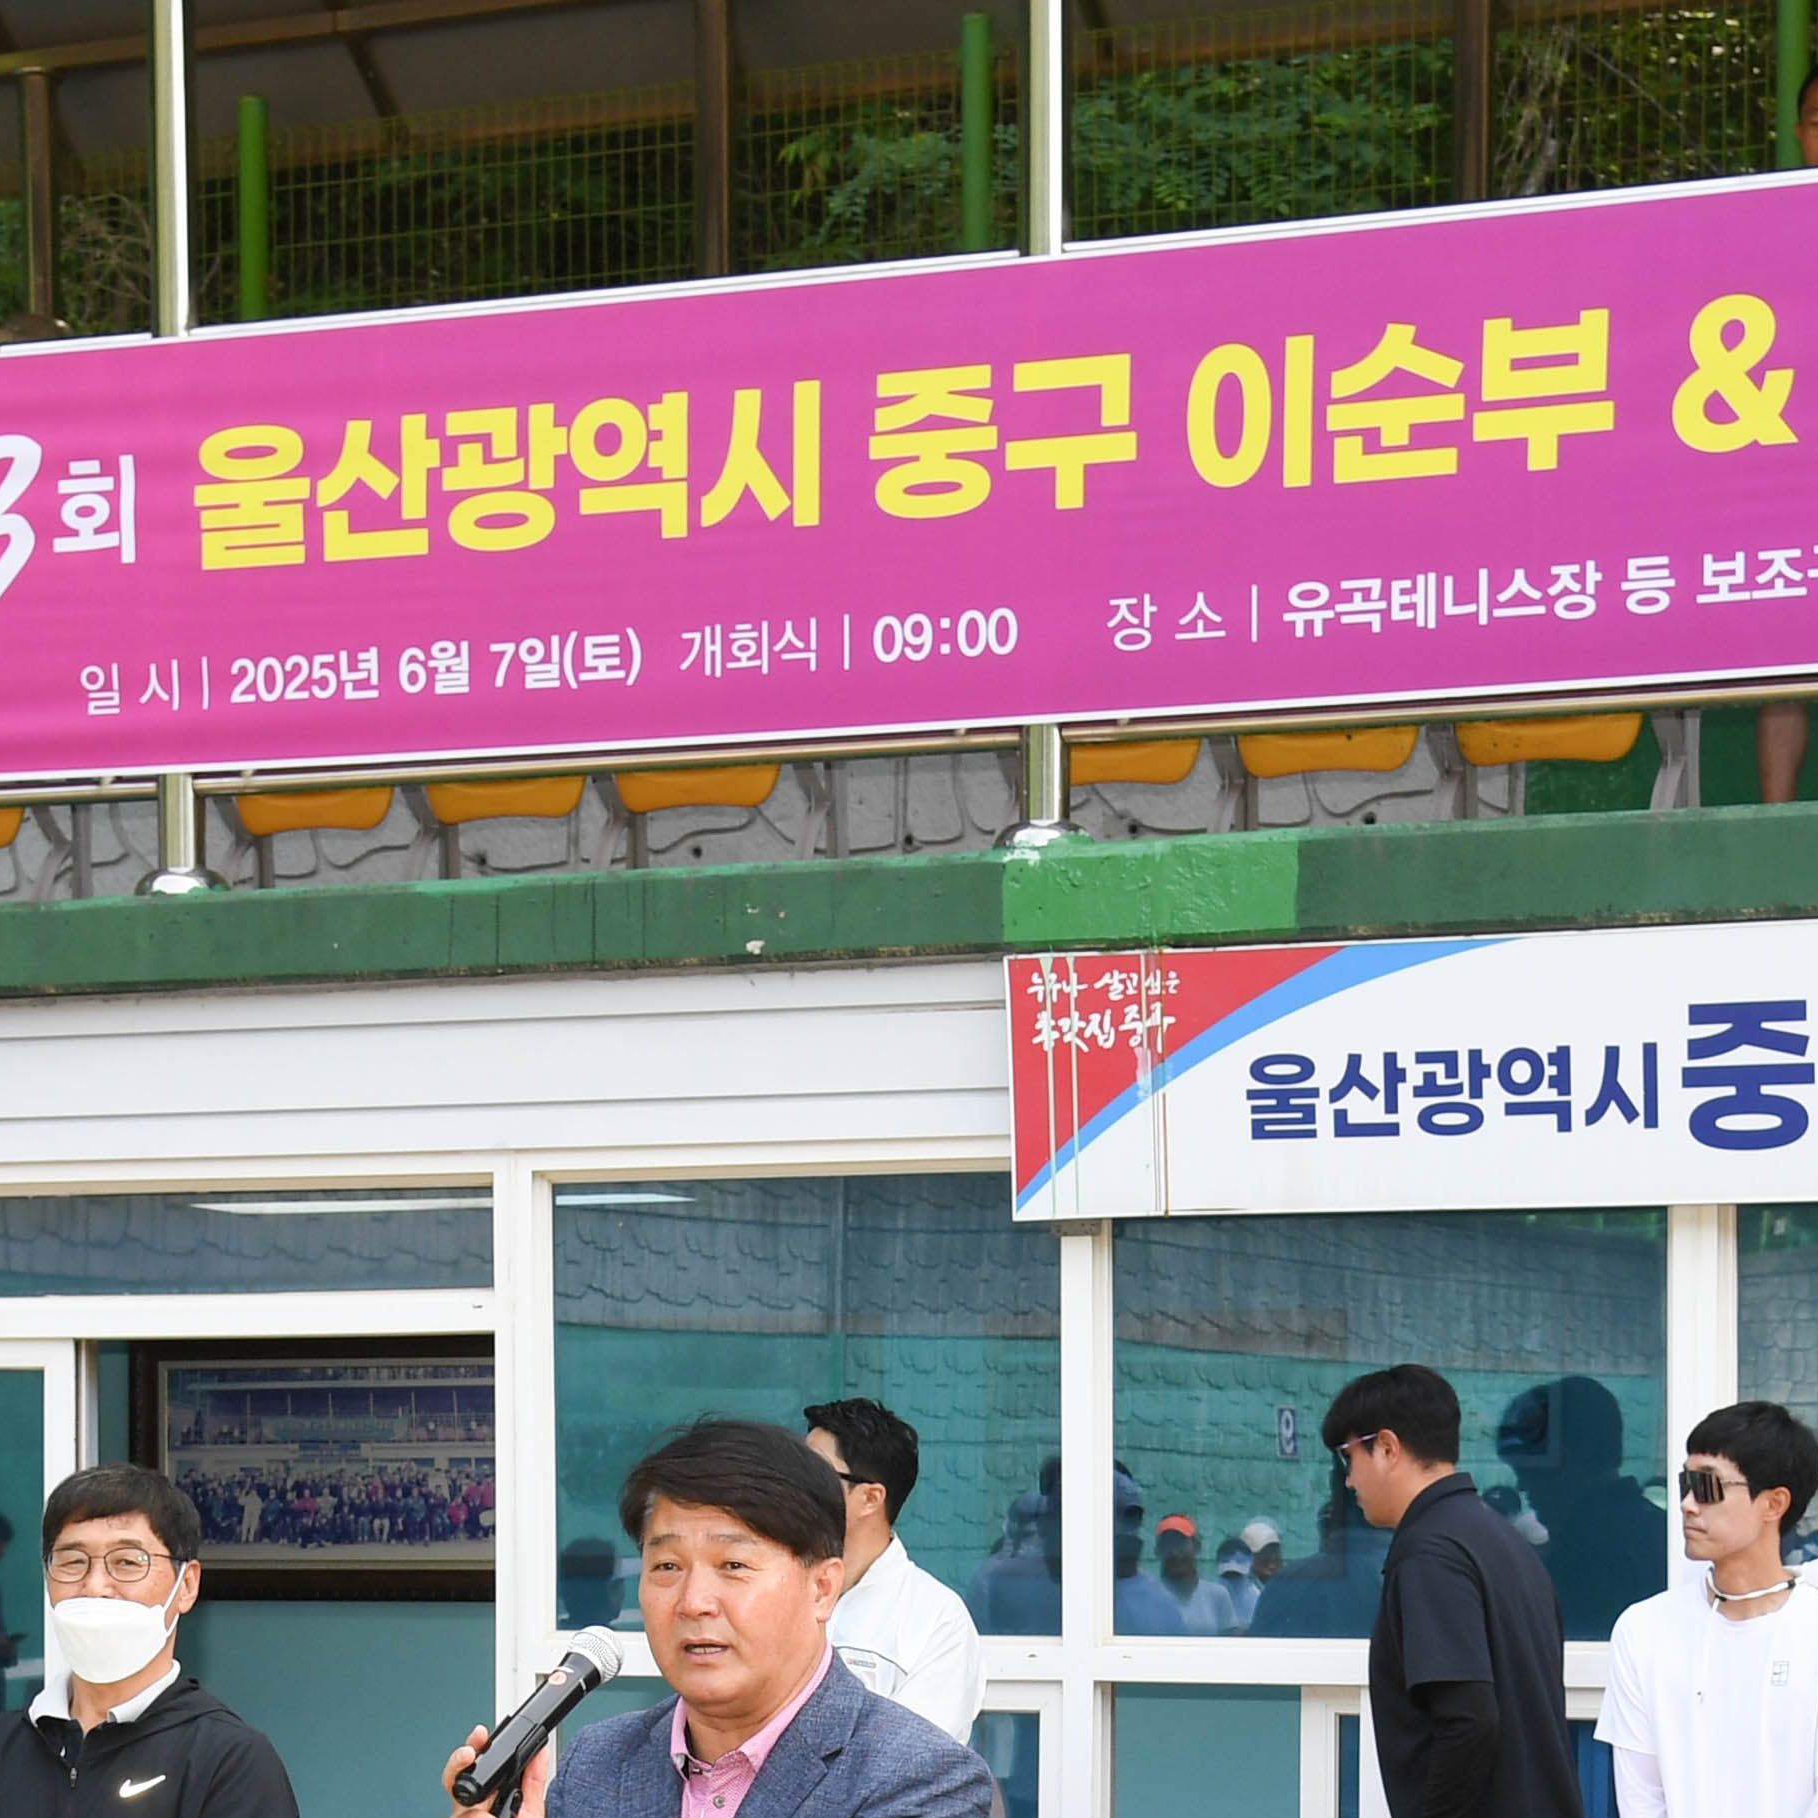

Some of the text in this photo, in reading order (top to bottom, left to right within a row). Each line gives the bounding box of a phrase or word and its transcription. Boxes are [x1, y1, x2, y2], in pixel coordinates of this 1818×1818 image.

[194, 380, 821, 570] 울산광역시
[869, 353, 1137, 519] 중구
[1187, 308, 1614, 488] 이순부
[1672, 293, 1799, 453] &
[1283, 559, 1602, 638] 유곡테니스장
[1620, 555, 1676, 614] 등
[230, 646, 380, 704] 2025년
[398, 640, 470, 695] 6월
[489, 627, 642, 689] 7일(토)
[680, 616, 818, 678] 개회식
[872, 607, 1018, 663] 09:00
[1027, 971, 1088, 1003] 누구나
[1094, 969, 1139, 1001] 살고
[1118, 1001, 1176, 1054] 중구
[1245, 1042, 1659, 1140] 울산광역시
